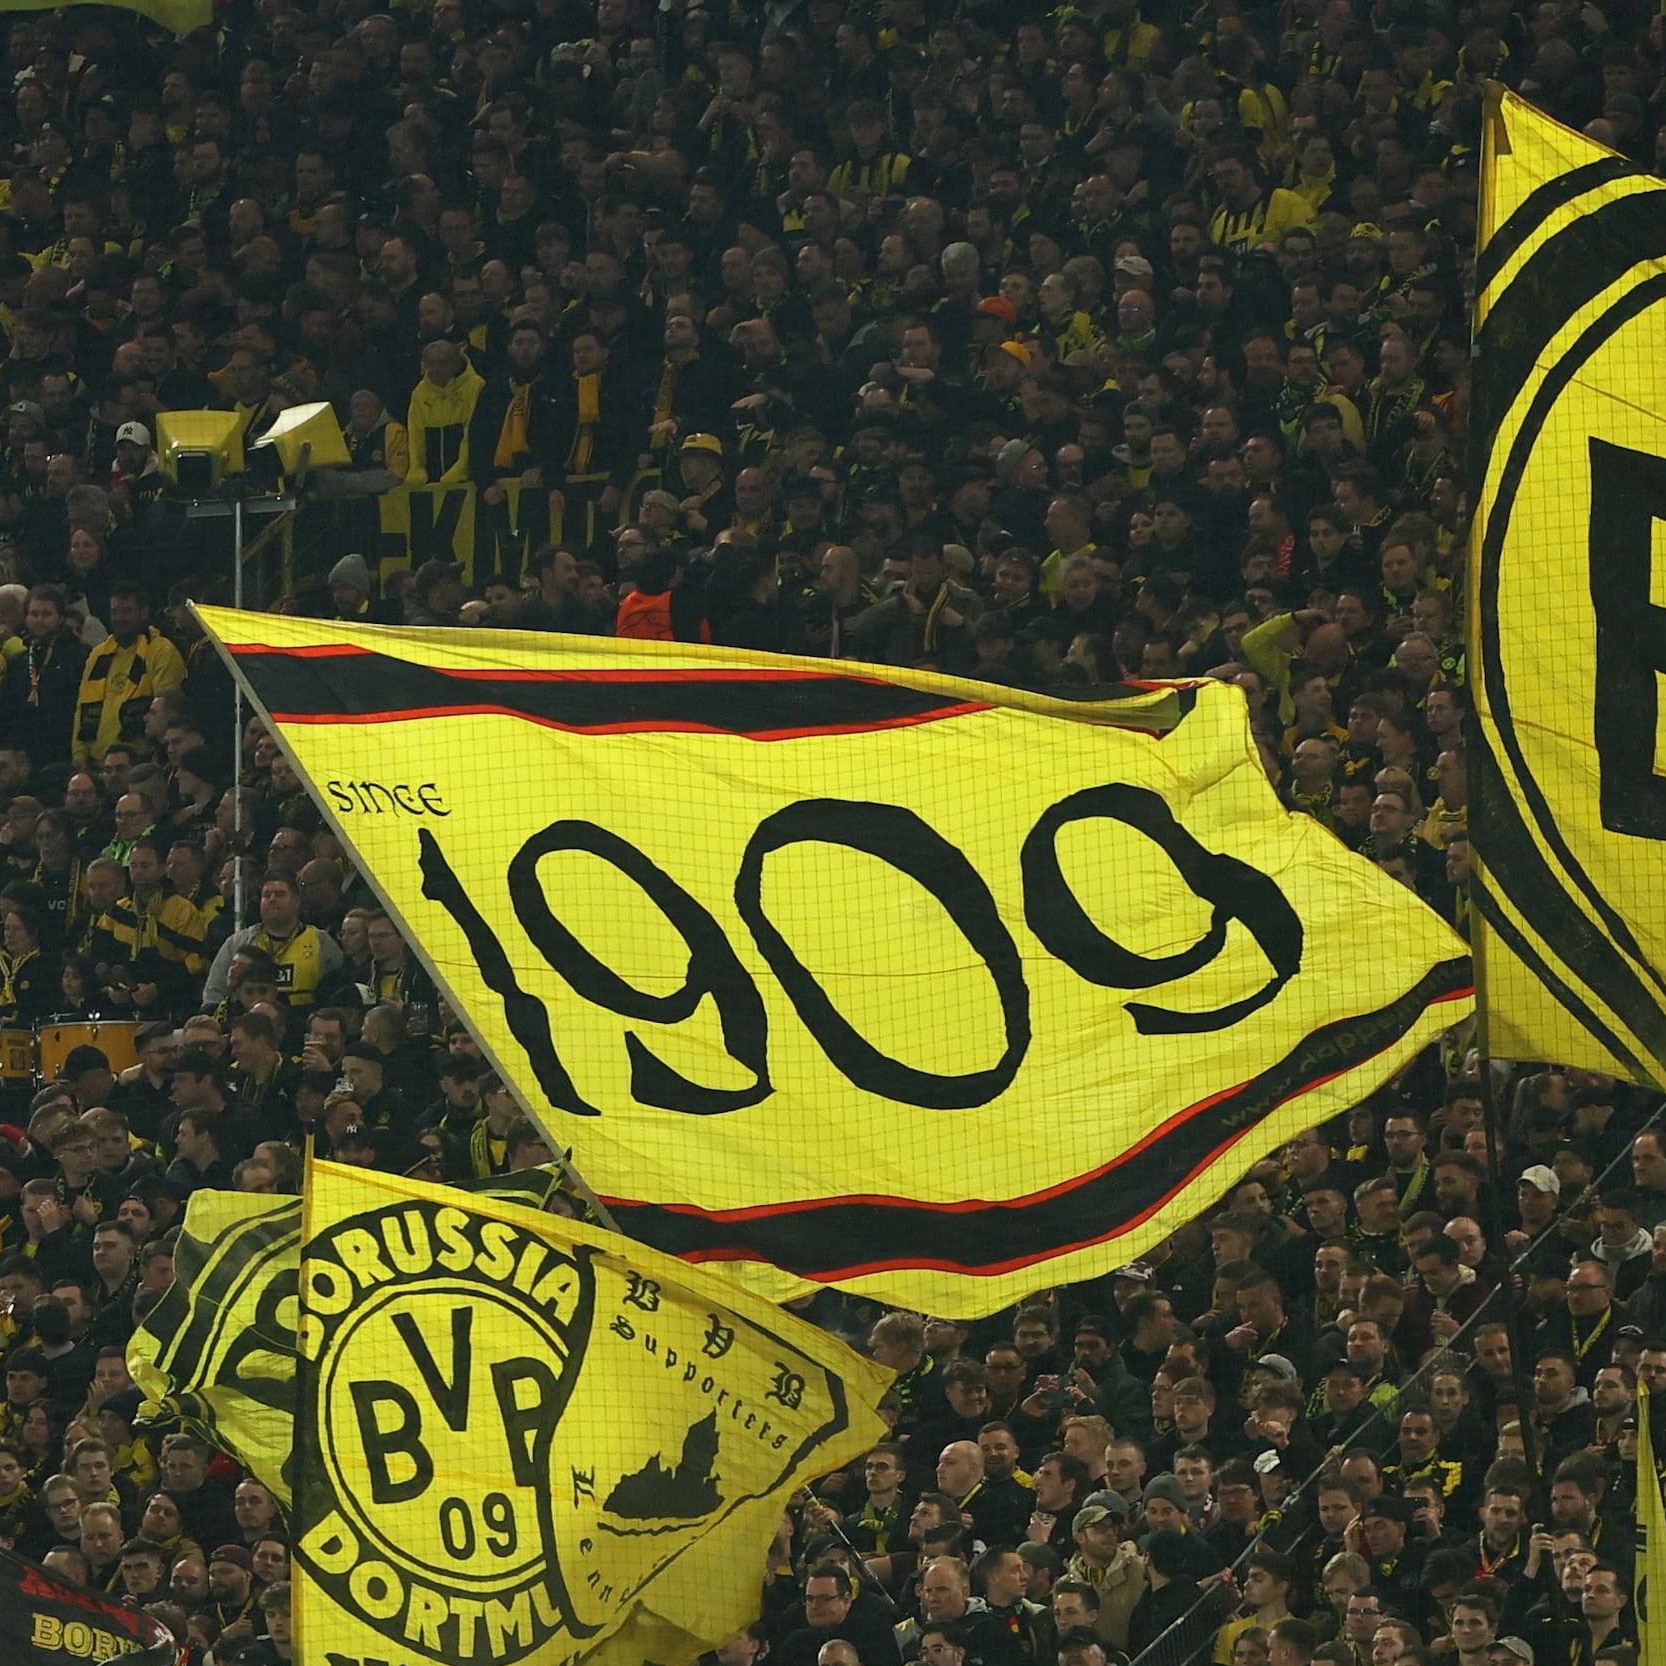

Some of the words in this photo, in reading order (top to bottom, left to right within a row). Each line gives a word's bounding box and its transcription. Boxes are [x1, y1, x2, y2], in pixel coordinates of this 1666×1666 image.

[417, 781, 1305, 1118] 1909
[609, 1315, 789, 1451] Supporters
[439, 1491, 518, 1562] 09
